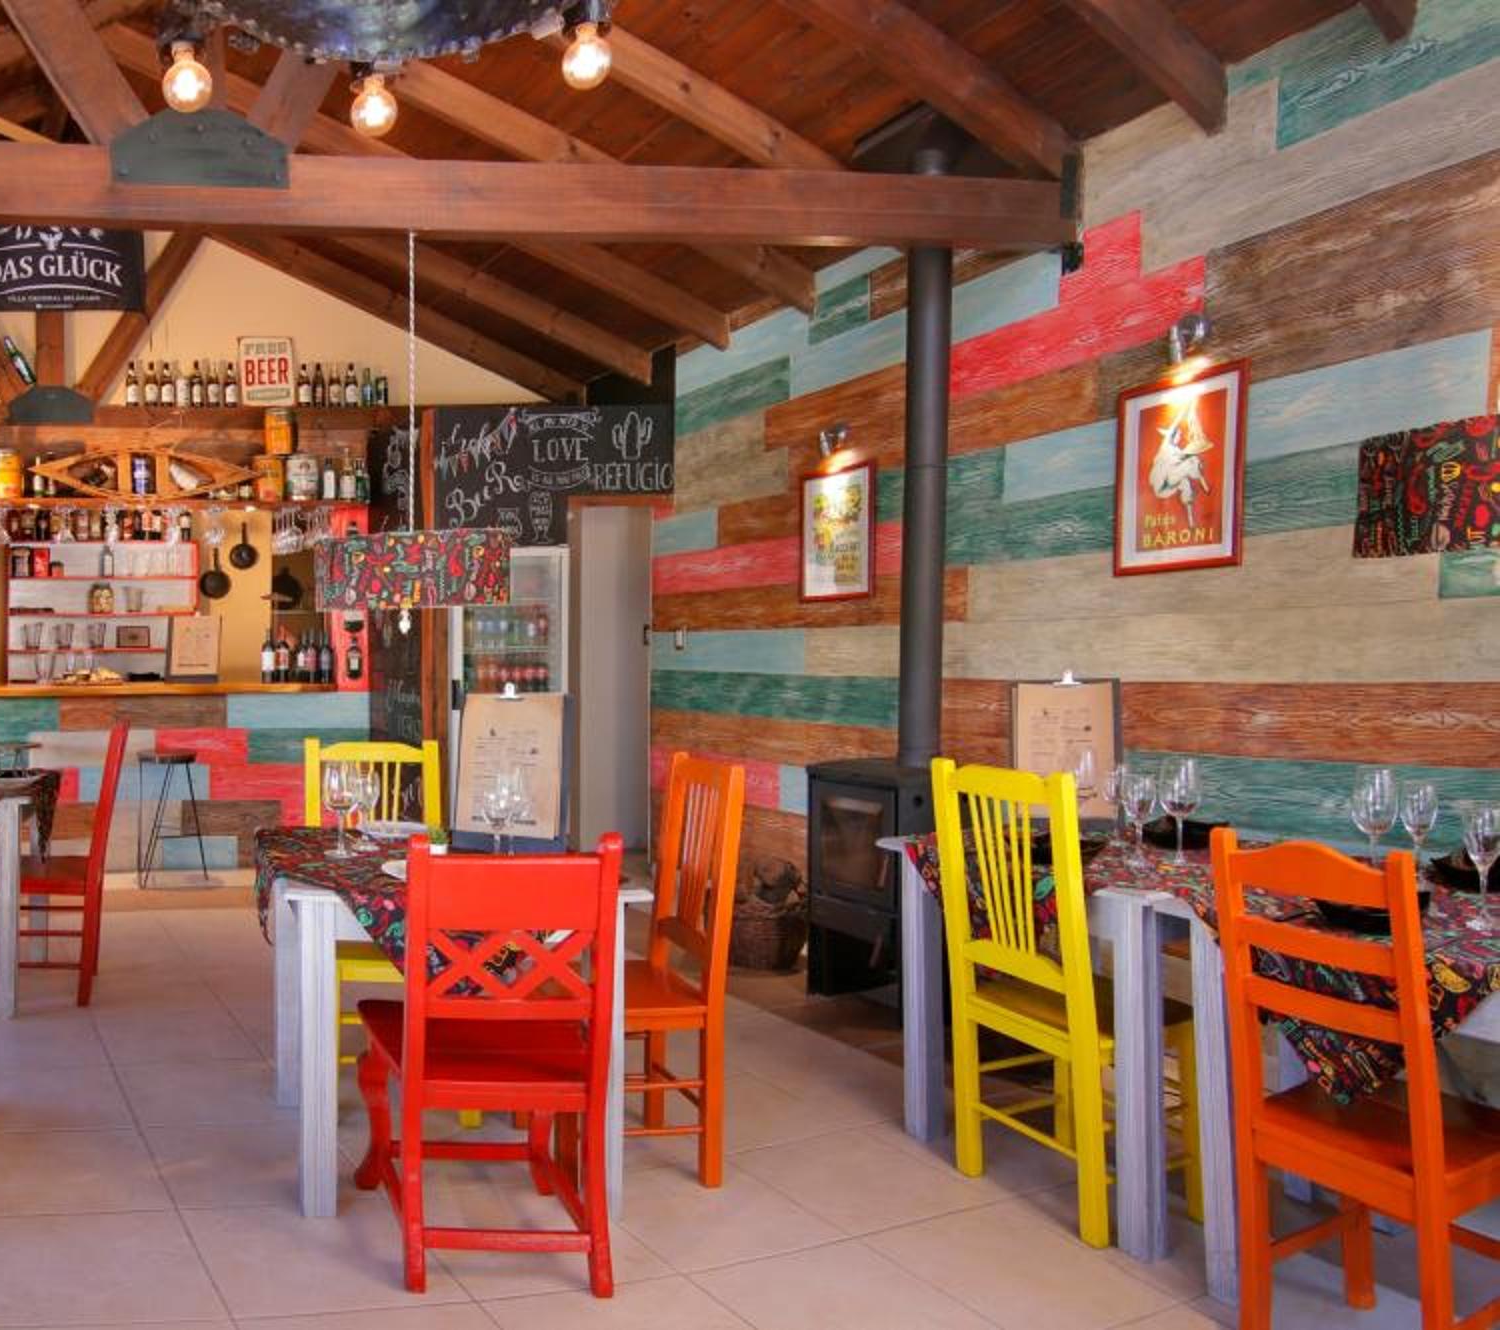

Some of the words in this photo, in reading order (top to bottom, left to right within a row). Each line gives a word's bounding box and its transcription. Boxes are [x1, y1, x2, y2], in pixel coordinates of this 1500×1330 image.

[38, 250, 123, 288] GLÜCK
[244, 357, 289, 386] BEER
[531, 438, 589, 462] LOVE
[1142, 528, 1214, 548] BARONI
